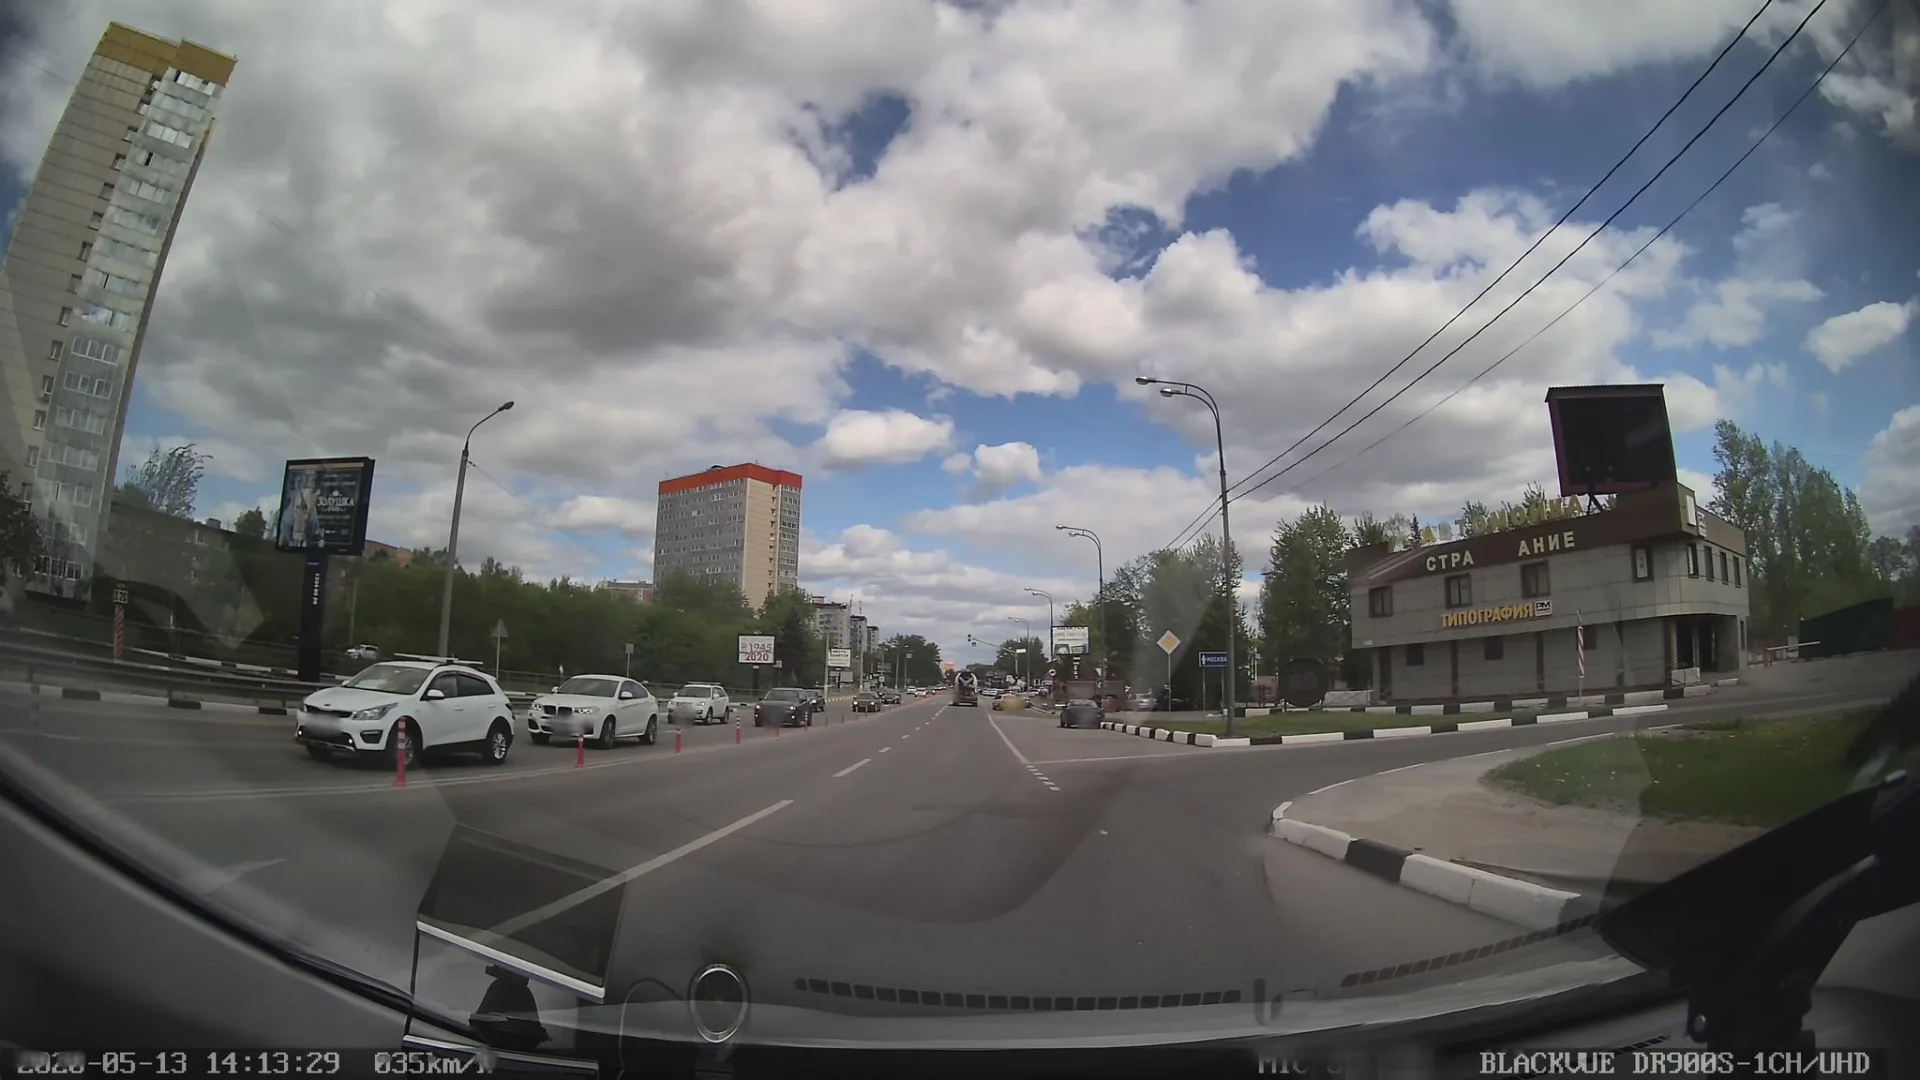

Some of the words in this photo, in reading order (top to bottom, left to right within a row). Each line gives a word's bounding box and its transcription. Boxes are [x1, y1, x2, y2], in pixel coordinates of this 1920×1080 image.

[1426, 550, 1475, 572] СТРА
[1518, 531, 1576, 557] АНИЕ
[1441, 602, 1534, 627] ТИПОГРАФИЯ
[745, 651, 769, 661] 2020
[749, 643, 772, 652] 1945
